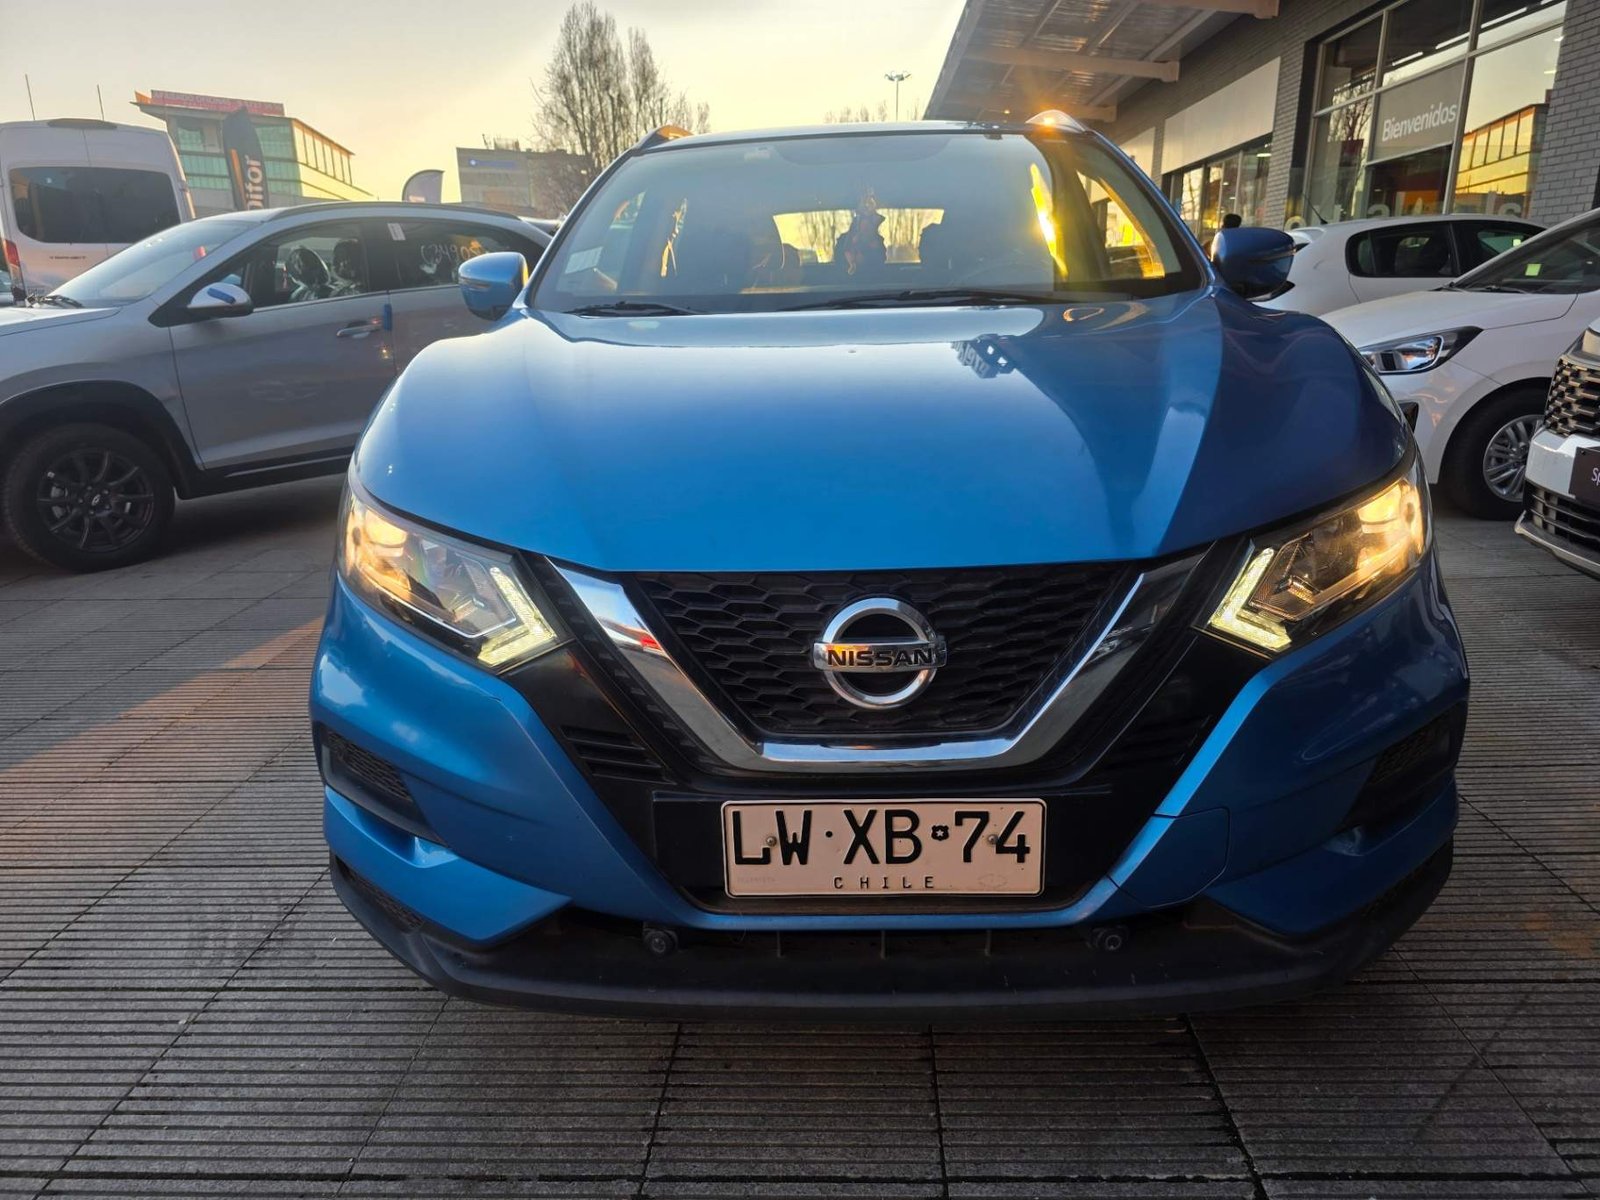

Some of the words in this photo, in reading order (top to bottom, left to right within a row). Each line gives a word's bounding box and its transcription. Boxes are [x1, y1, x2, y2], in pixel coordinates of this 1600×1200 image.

[1382, 102, 1457, 142] Bienvenidos
[827, 648, 932, 667] NISSAN
[834, 876, 935, 890] CHILE
